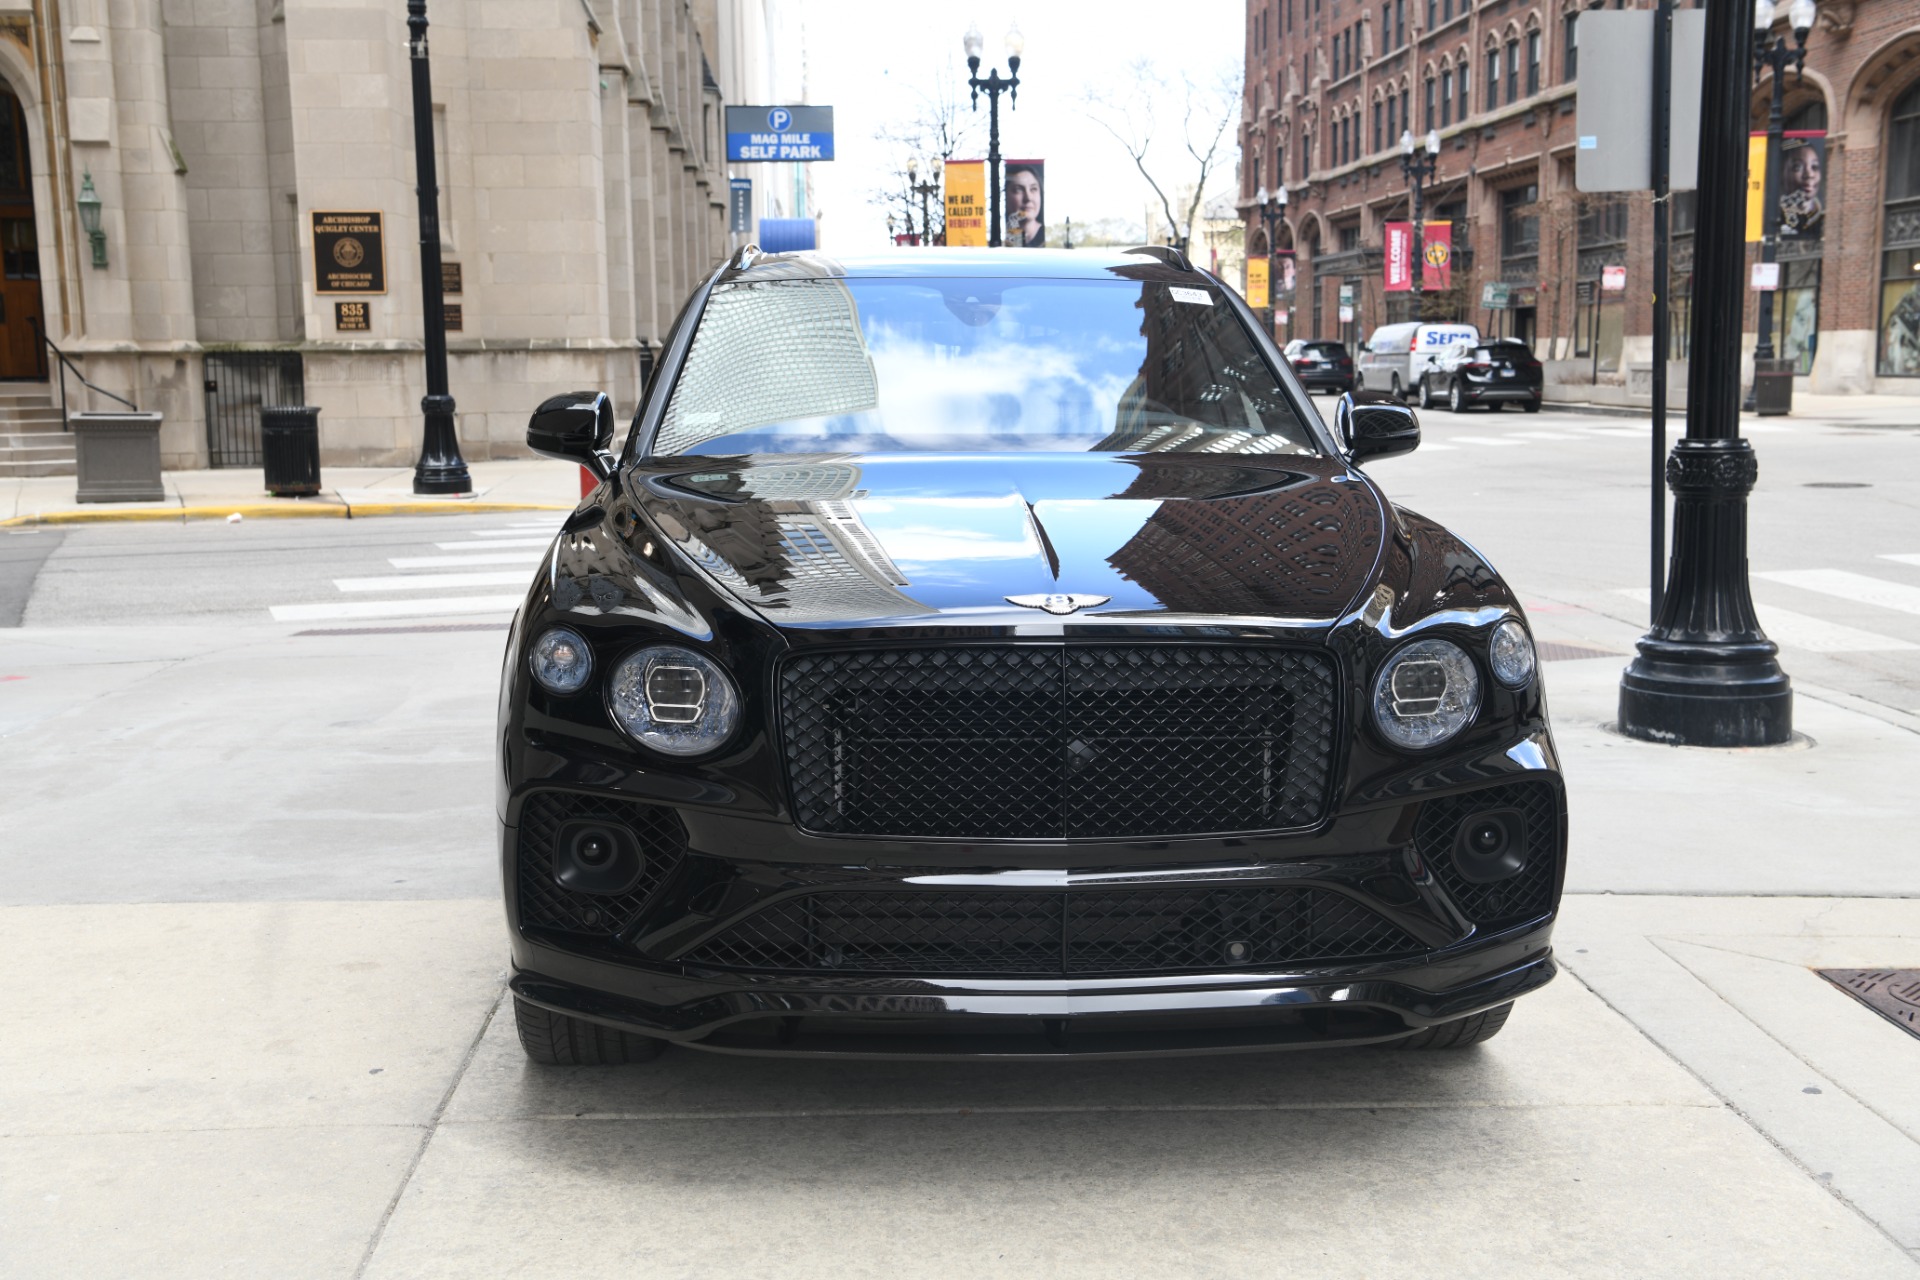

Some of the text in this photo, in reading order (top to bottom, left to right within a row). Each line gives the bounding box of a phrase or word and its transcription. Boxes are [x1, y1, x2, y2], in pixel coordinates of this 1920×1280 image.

[750, 133, 811, 144] MAG MILE
[740, 145, 822, 159] SELF PARK
[948, 195, 974, 205] WE ARE
[948, 207, 984, 216] CALLED TO
[322, 216, 371, 224] ARCHBISHOP
[948, 219, 982, 229] REDEFINE
[315, 225, 379, 233] QUIGLEY CENTER
[1390, 229, 1401, 285] WELCOME
[327, 272, 373, 280] ARCHDIOCESE
[341, 303, 364, 316] 835
